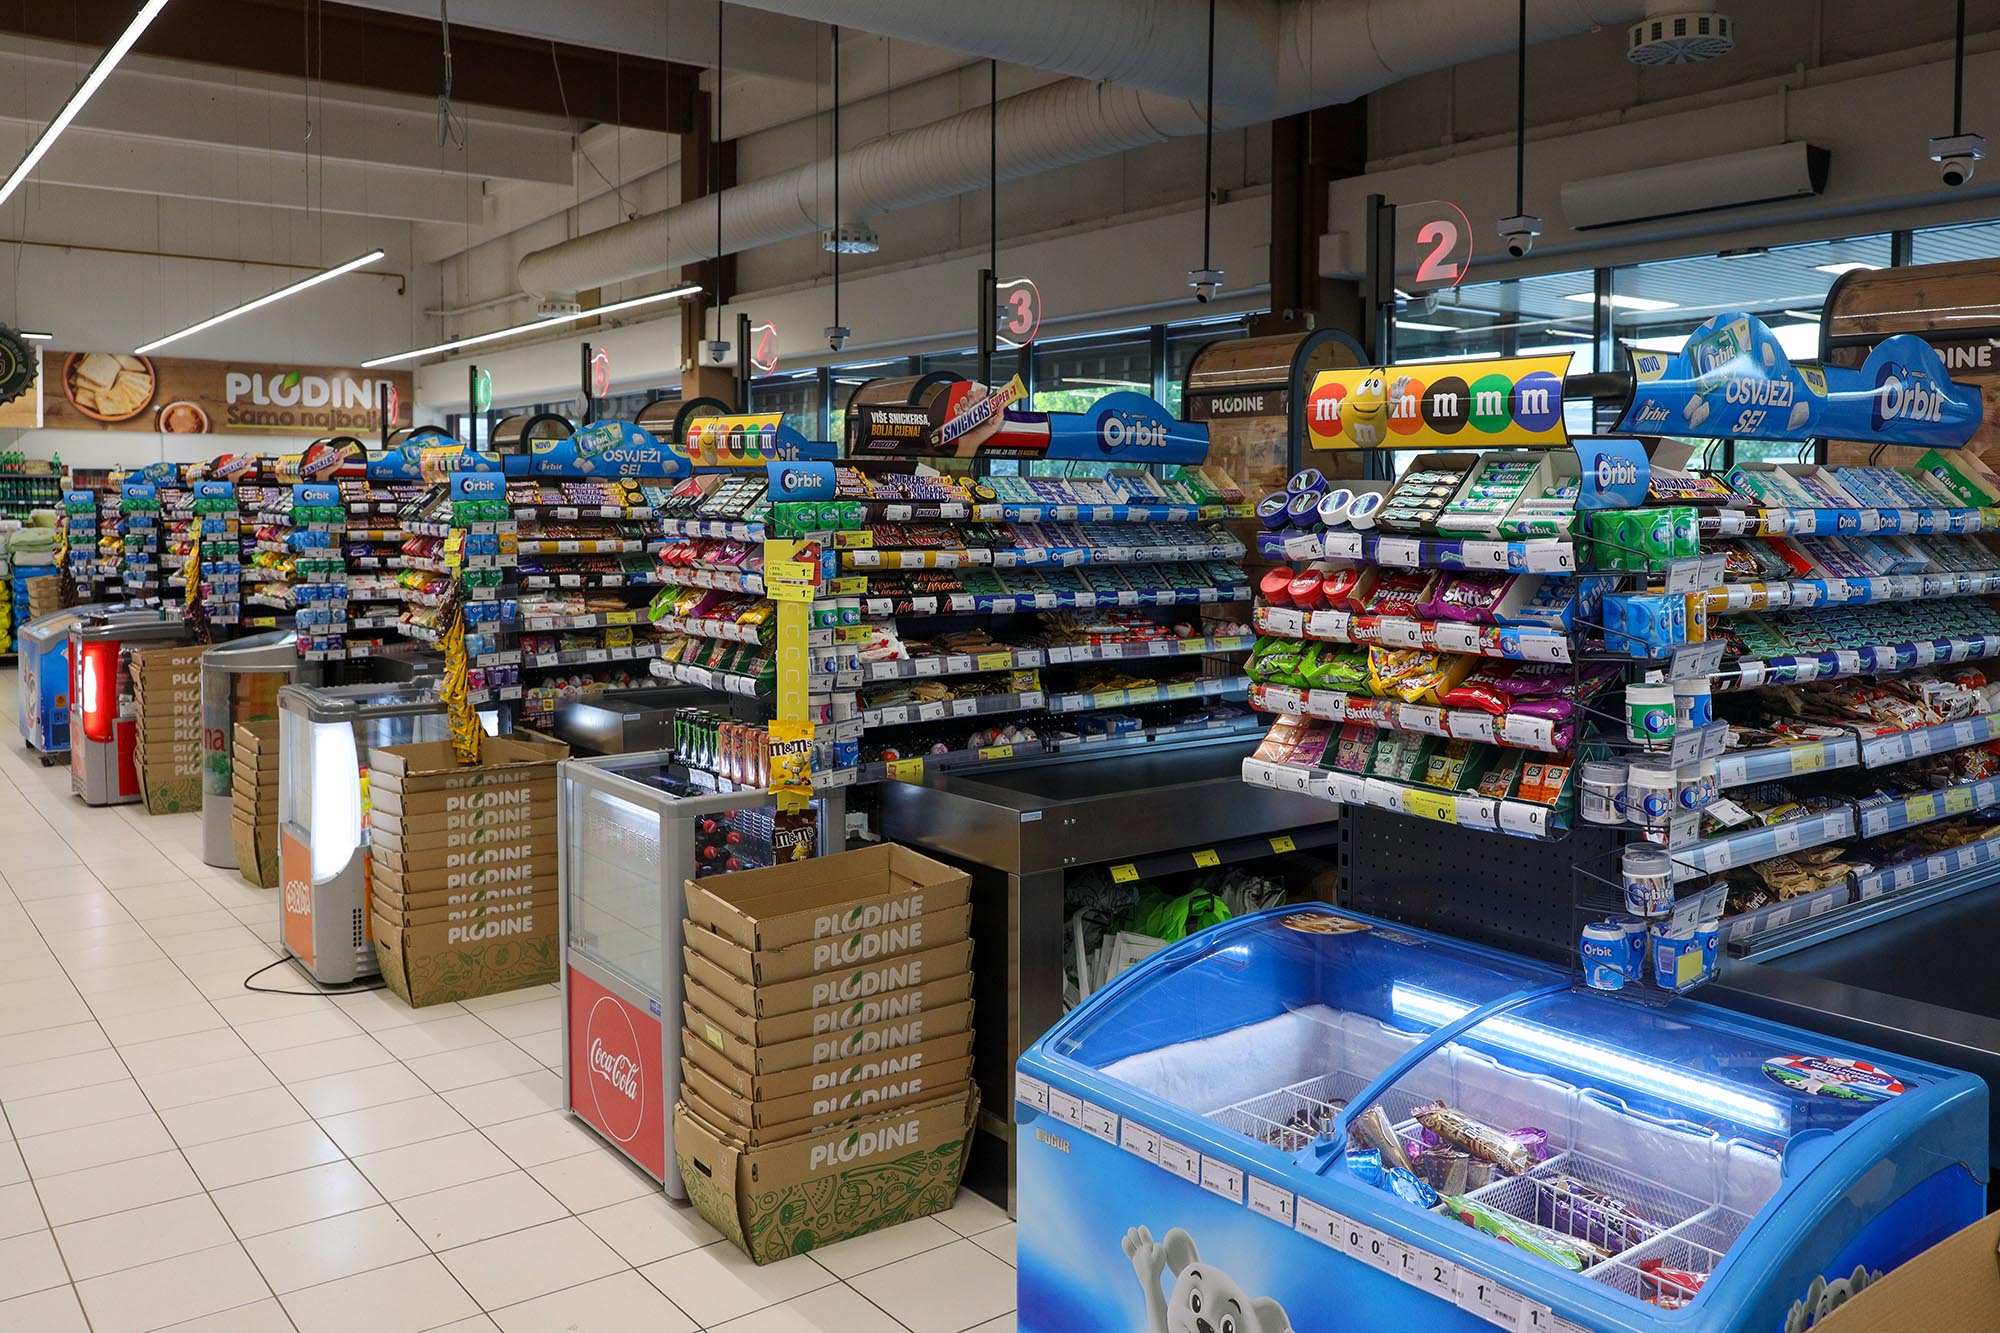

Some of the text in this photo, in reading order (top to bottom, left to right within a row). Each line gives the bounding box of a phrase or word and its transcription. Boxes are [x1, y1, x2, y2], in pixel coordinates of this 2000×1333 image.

[1415, 220, 1458, 283] 2
[1008, 289, 1033, 334] 3
[1637, 355, 1661, 374] NOVO
[1705, 344, 1736, 371] Orbit
[1807, 371, 1824, 388] NOVO
[1725, 374, 1794, 408] OSVJEŽI
[1212, 396, 1264, 413] PLODINE
[1392, 394, 1417, 418] m
[1433, 391, 1458, 417] m
[1476, 389, 1503, 416] m
[1521, 387, 1549, 414] m
[1881, 376, 1945, 423] Orbit
[227, 407, 295, 425] Samo
[943, 400, 991, 442] SNICKERS
[990, 390, 1011, 411] SUPER
[1315, 397, 1338, 421] m
[1636, 405, 1672, 422] Orbit
[871, 411, 931, 427] VIŠE SNICKERSA,
[1732, 409, 1767, 433] SE!
[871, 426, 921, 437] BOLJA CIJENA!
[1103, 415, 1168, 448] Orbit
[1354, 423, 1377, 442] m
[689, 434, 699, 449] m
[717, 434, 726, 449] m
[731, 434, 741, 449] m
[747, 434, 757, 449] m
[762, 434, 772, 449] m
[603, 448, 661, 463] OSVJEŽI
[306, 455, 335, 474] SNICKERS
[619, 464, 641, 475] SE!
[784, 471, 822, 488] Orbit
[889, 474, 926, 485] SNICKERS
[1599, 460, 1637, 487] Orbit
[463, 479, 495, 492] Orbit
[1655, 477, 1697, 491] SNICKERS
[1736, 477, 1759, 499] Orbit
[1937, 471, 1957, 491] Orbit
[129, 487, 149, 496] Orbit
[202, 486, 225, 496] Orbit
[304, 490, 329, 501] Orbit
[916, 509, 940, 517] SNICKERS
[1527, 524, 1552, 534] Orbit
[1838, 515, 1857, 529] Orbit
[1880, 515, 1897, 529] Orbit
[1310, 544, 1317, 554] 4
[1348, 543, 1355, 553] 4
[1405, 551, 1411, 562] 1
[1493, 550, 1501, 561] 0
[1559, 555, 1567, 567] 0
[801, 568, 806, 576] 1
[1689, 575, 1694, 585] 4
[801, 590, 806, 598] 1
[1847, 585, 1865, 597] Orbit
[1288, 619, 1295, 630] 2
[1335, 619, 1341, 629] 2
[1354, 626, 1381, 639] Skittl
[1408, 630, 1415, 641] 0
[1465, 635, 1472, 646] 0
[1551, 646, 1559, 657] 0
[1691, 659, 1697, 670] 4
[1288, 701, 1294, 710] 0
[1333, 699, 1340, 709] 0
[1345, 708, 1386, 721] Skittles
[1424, 715, 1431, 726] 0
[1479, 723, 1485, 734] 1
[1534, 728, 1540, 739] 1
[1263, 771, 1270, 781] 0
[1297, 778, 1304, 788] 0
[1328, 786, 1335, 796] 0
[1351, 789, 1357, 799] 0
[446, 788, 531, 812] PLODINE
[1389, 796, 1396, 807] 0
[448, 807, 531, 831] PLODINE
[1438, 807, 1446, 819] 0
[1481, 807, 1488, 818] 0
[1530, 812, 1537, 823] 0
[448, 825, 532, 847] PLODINE
[1687, 826, 1692, 836] 4
[447, 845, 532, 868] PLODINE
[448, 864, 532, 889] PLODINE
[814, 895, 923, 939] PLODINE
[448, 916, 533, 945] PLODINE
[813, 923, 922, 970] PLODINE
[1583, 944, 1612, 958] Orbit
[812, 961, 922, 1009] PLODINE
[812, 992, 923, 1036] PLODINE
[812, 1021, 923, 1065] PLODINE
[590, 1038, 640, 1100] Coca-Cola
[1038, 1091, 1043, 1103] 2
[1070, 1107, 1076, 1118] 2
[1103, 1121, 1110, 1134] 2
[809, 1120, 920, 1171] PLODINE
[1147, 1140, 1154, 1152] 2
[1186, 1159, 1191, 1171] 1
[1228, 1177, 1233, 1190] 1
[1280, 1200, 1285, 1213] 1
[1328, 1222, 1334, 1236] 1
[1350, 1231, 1358, 1245] 0
[1371, 1240, 1380, 1254] 0
[1401, 1253, 1408, 1267] 1
[1433, 1266, 1442, 1282] 2
[1477, 1284, 1484, 1300] 1
[1531, 1310, 1537, 1326] 1
